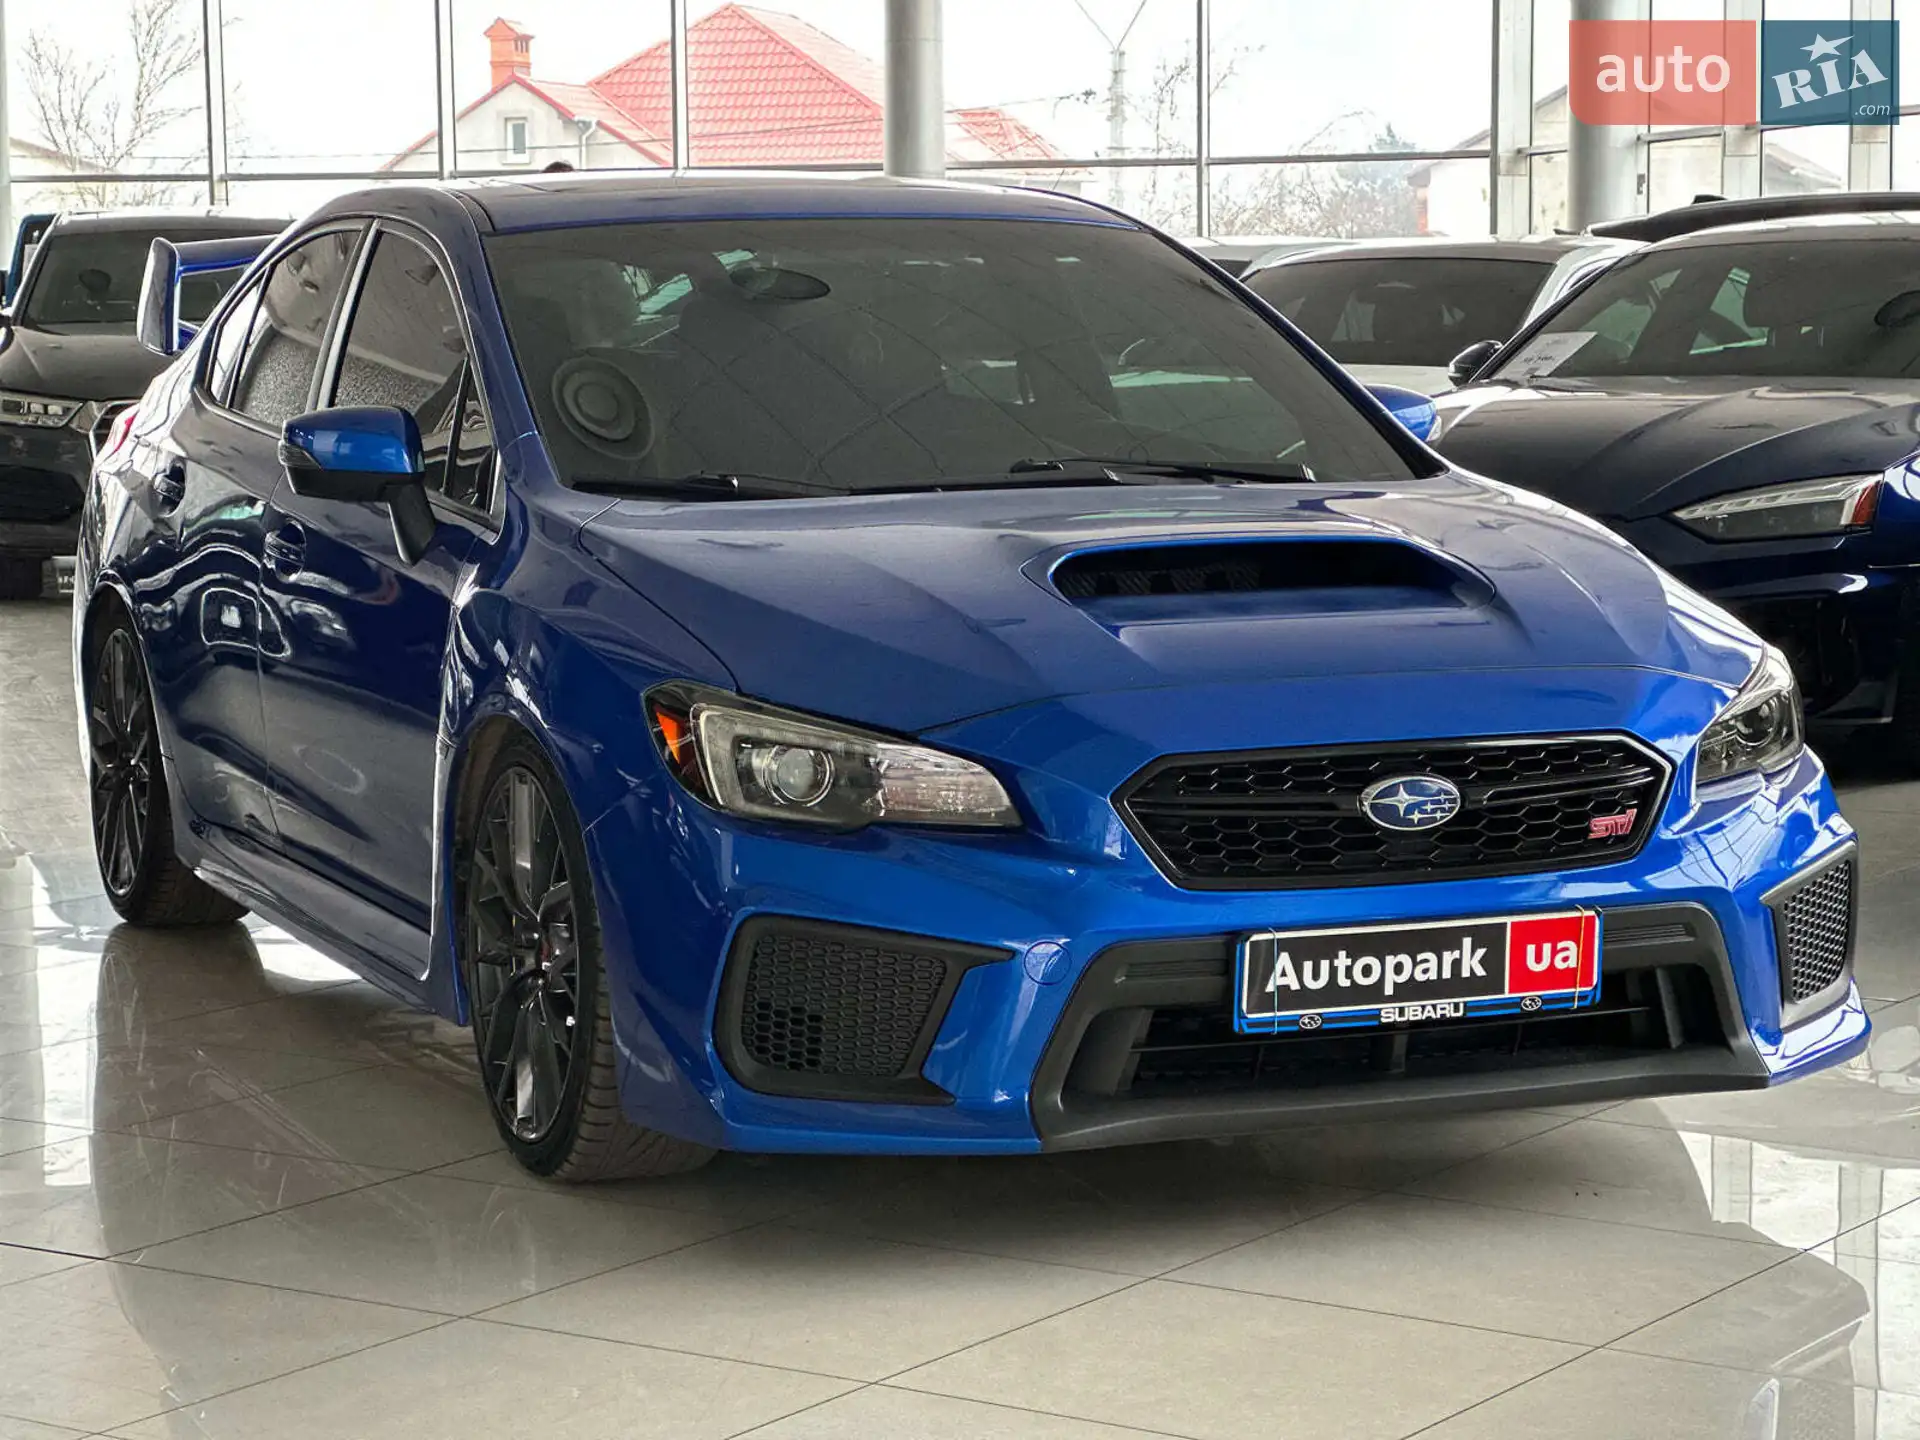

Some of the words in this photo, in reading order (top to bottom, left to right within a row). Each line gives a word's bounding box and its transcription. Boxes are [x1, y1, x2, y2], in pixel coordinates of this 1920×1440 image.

[1265, 937, 1487, 996] Autopark
[1525, 939, 1579, 972] ua
[1380, 1002, 1465, 1023] SUBARU
